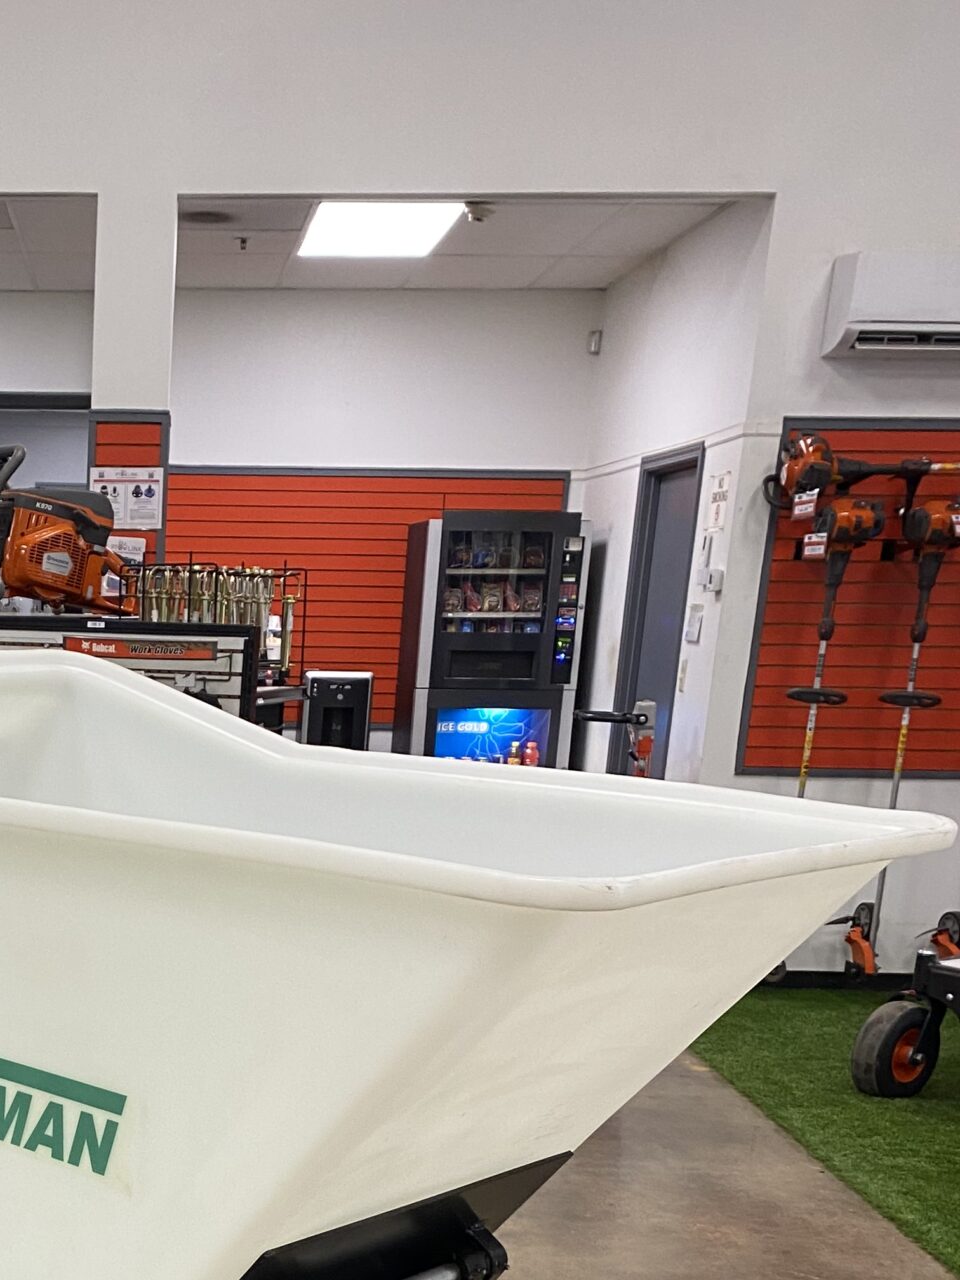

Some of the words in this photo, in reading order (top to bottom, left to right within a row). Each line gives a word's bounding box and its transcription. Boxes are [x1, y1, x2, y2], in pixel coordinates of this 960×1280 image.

[92, 642, 115, 653] Bobcat
[130, 644, 151, 655] Work
[154, 645, 184, 656] Gloves
[437, 722, 455, 732] ICE
